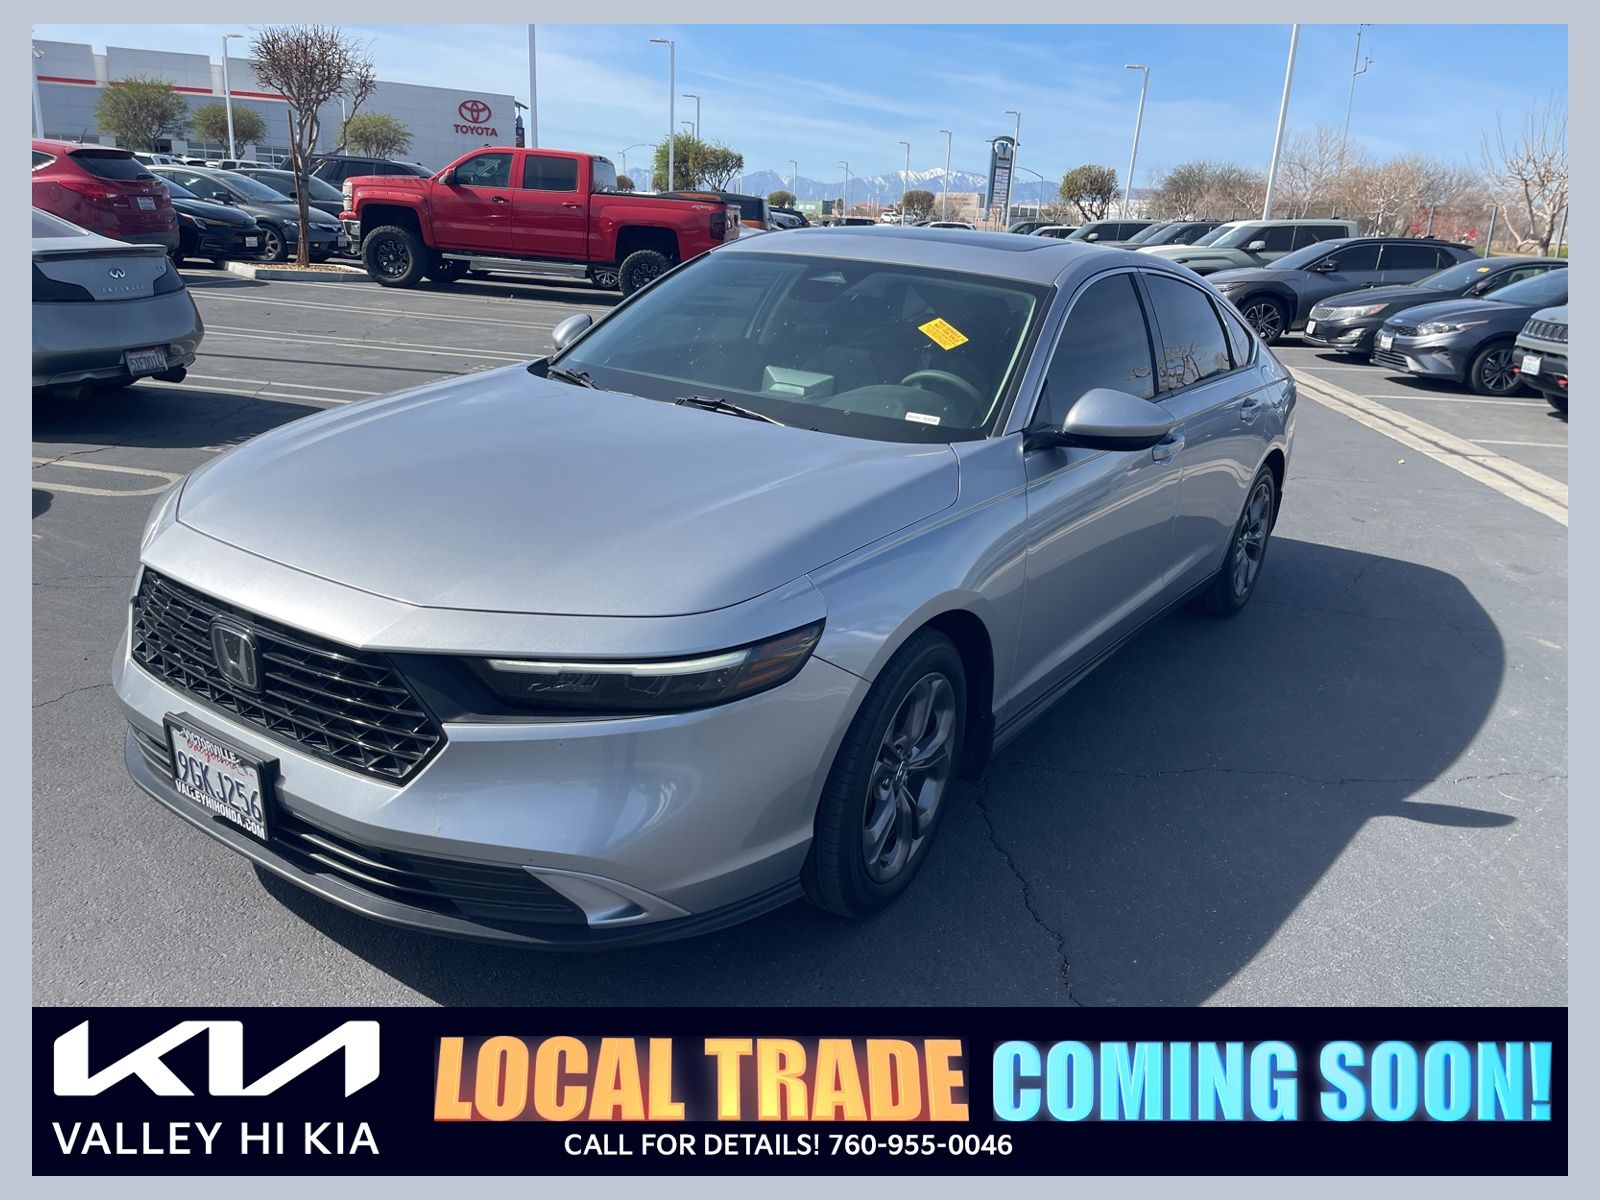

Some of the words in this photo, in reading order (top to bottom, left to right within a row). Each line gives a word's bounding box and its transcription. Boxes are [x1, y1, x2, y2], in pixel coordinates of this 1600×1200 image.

[453, 124, 498, 137] TOYOTA
[184, 729, 237, 763] VICTORVILLE
[175, 778, 266, 840] VALLEYHIHONDA.COM
[177, 750, 262, 823] 9GKJ256
